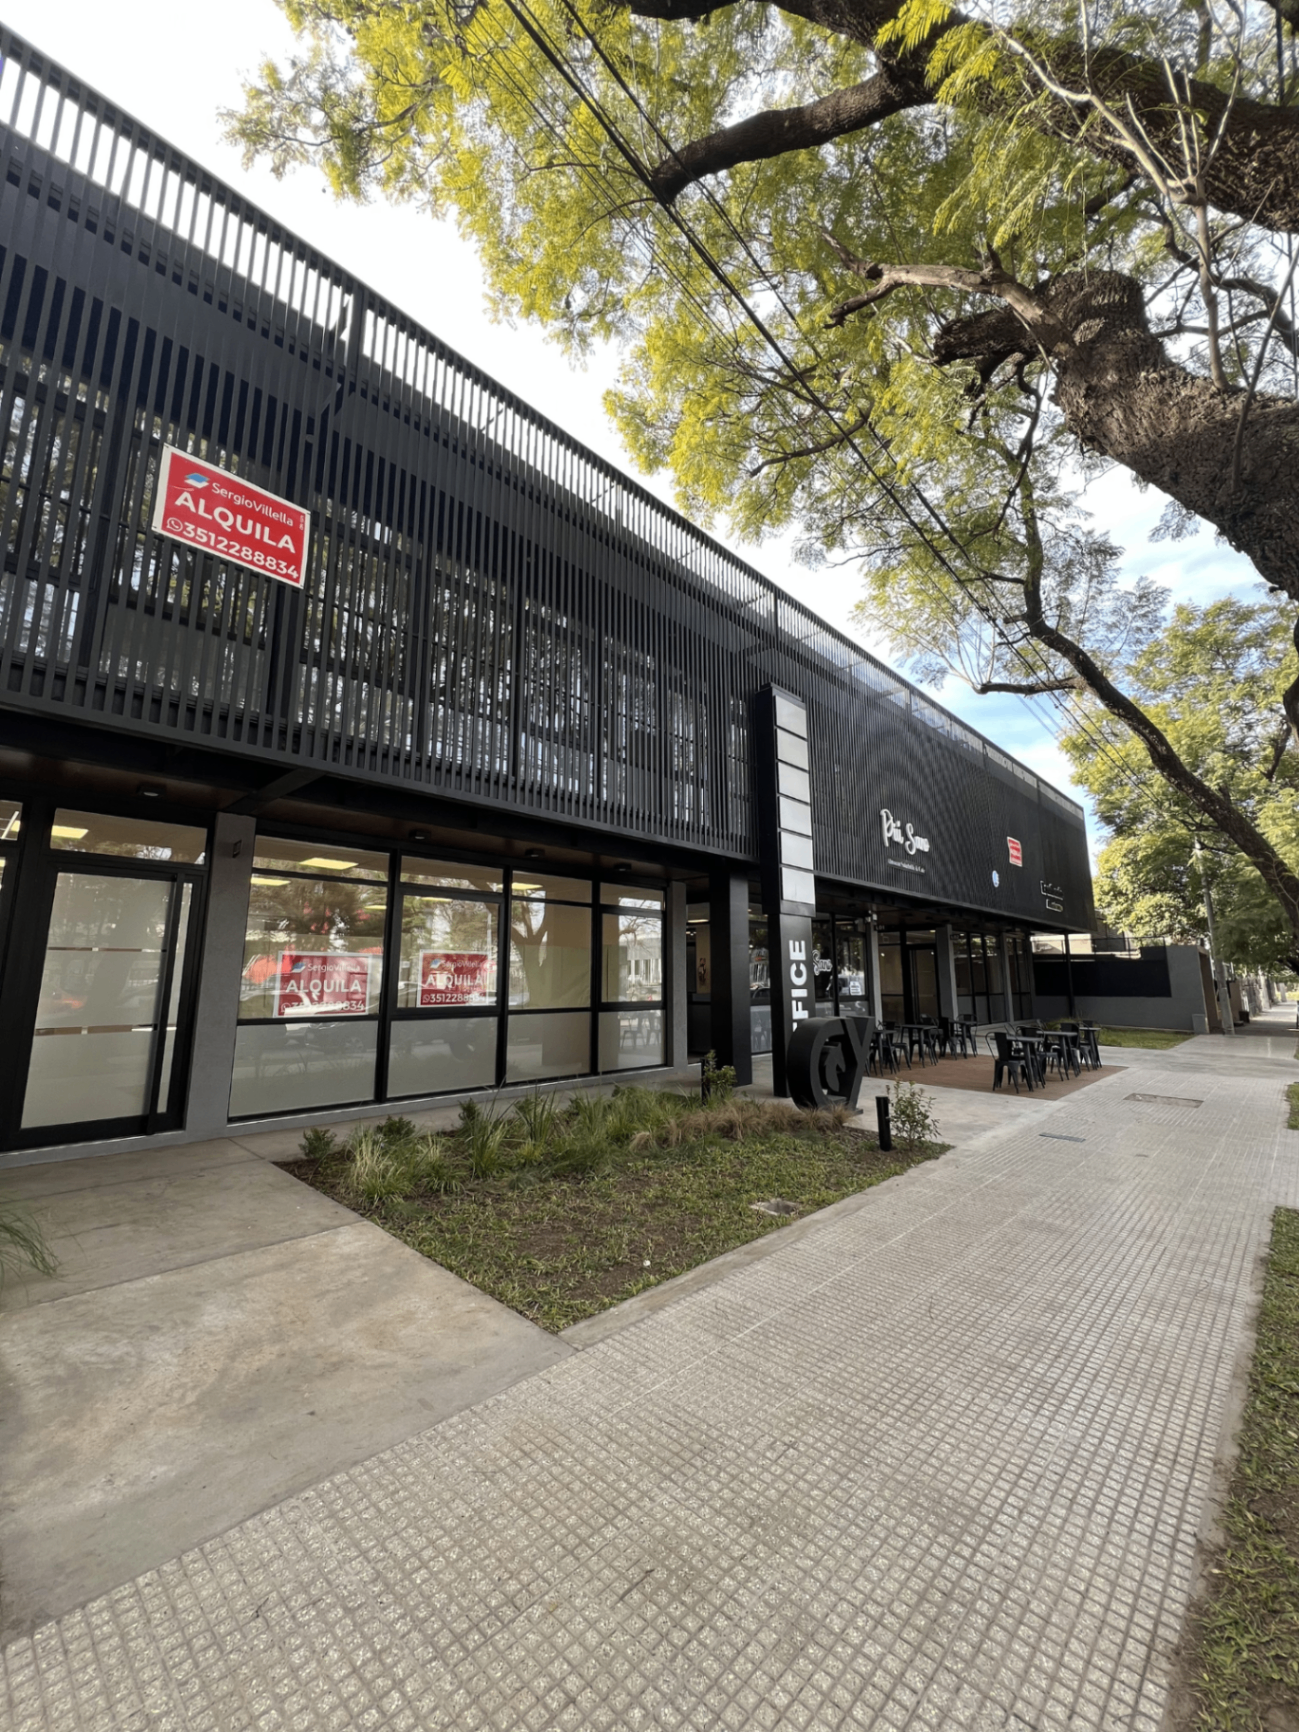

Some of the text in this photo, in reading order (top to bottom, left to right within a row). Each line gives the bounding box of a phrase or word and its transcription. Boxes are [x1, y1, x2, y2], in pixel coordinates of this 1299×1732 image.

[174, 491, 296, 554] ALQUILA
[212, 482, 293, 527] SergioVillella
[183, 521, 299, 579] 3512288834
[286, 979, 362, 995] ALQUILA
[425, 973, 483, 989] ALQUILA
[788, 939, 809, 1032] FICE
